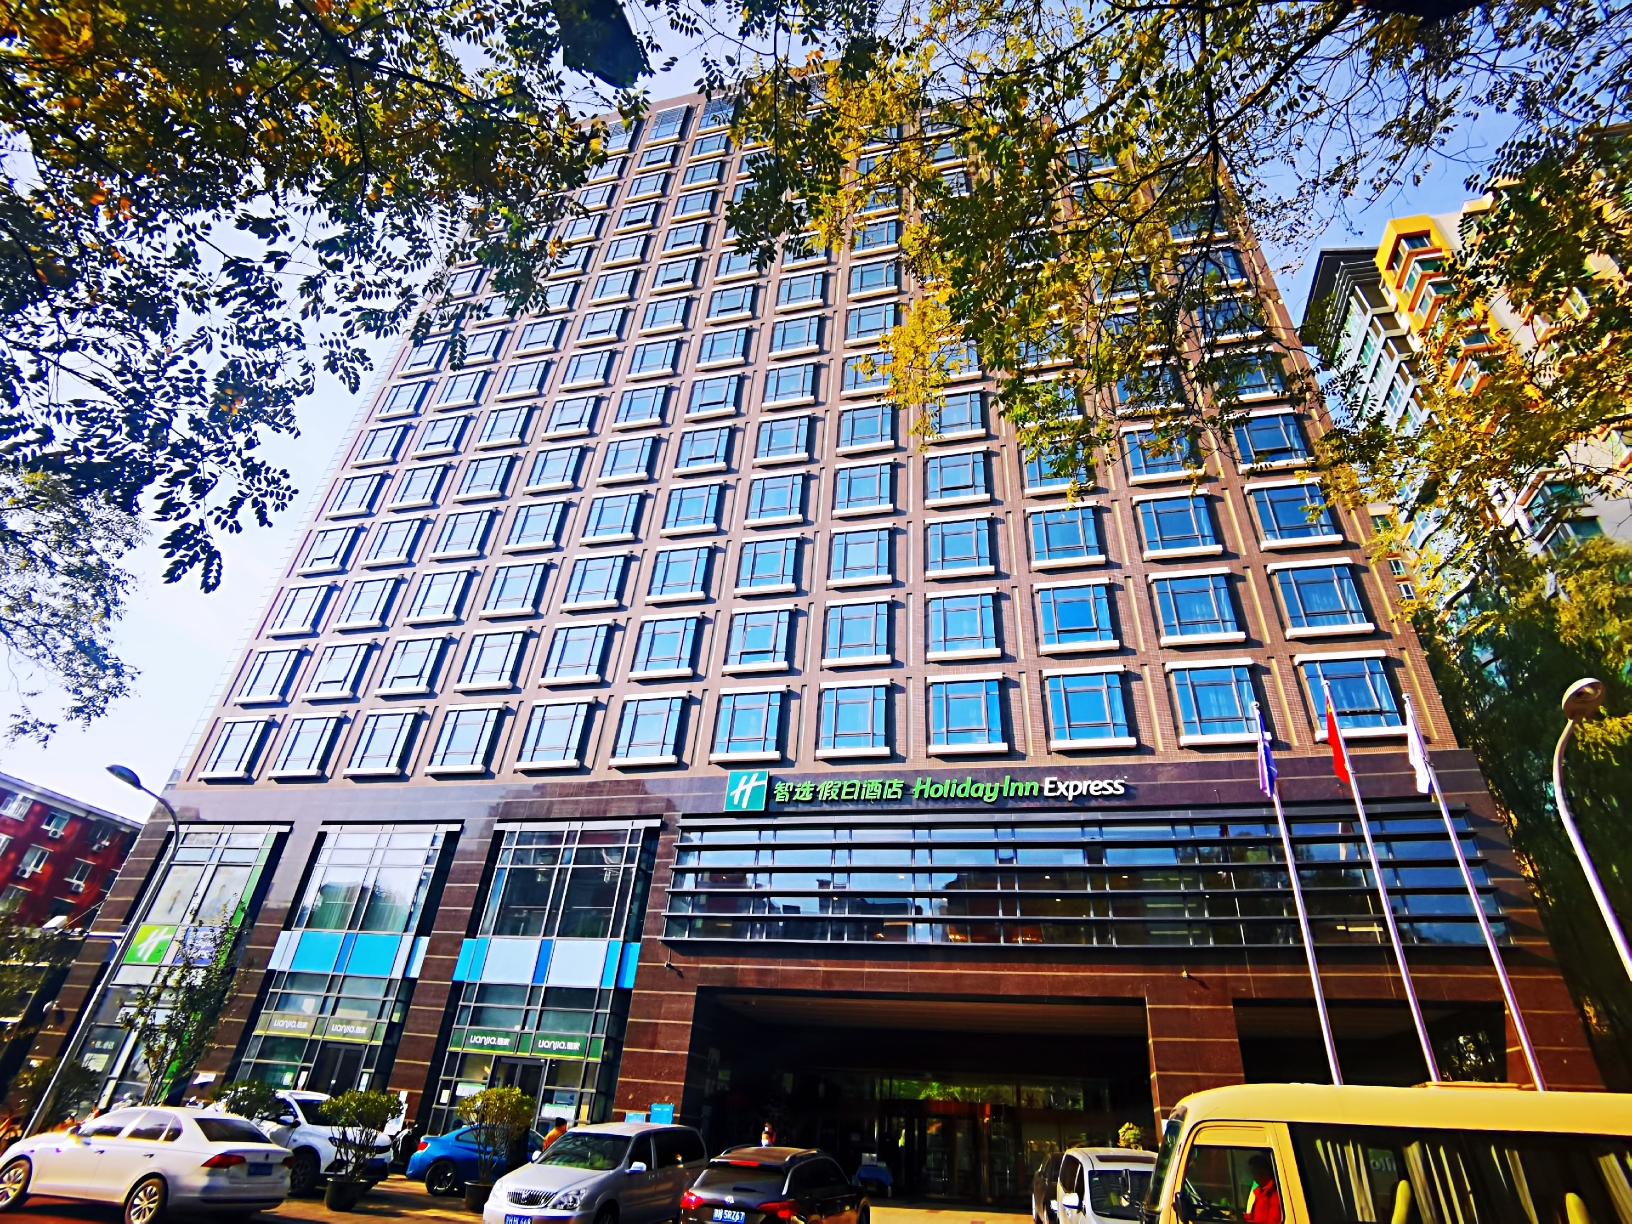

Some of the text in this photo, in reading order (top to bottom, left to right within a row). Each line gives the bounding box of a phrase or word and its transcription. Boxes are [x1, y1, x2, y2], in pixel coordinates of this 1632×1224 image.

[774, 779, 904, 802] 智选假日酒店
[913, 775, 1125, 802] Holiday Inn Express
